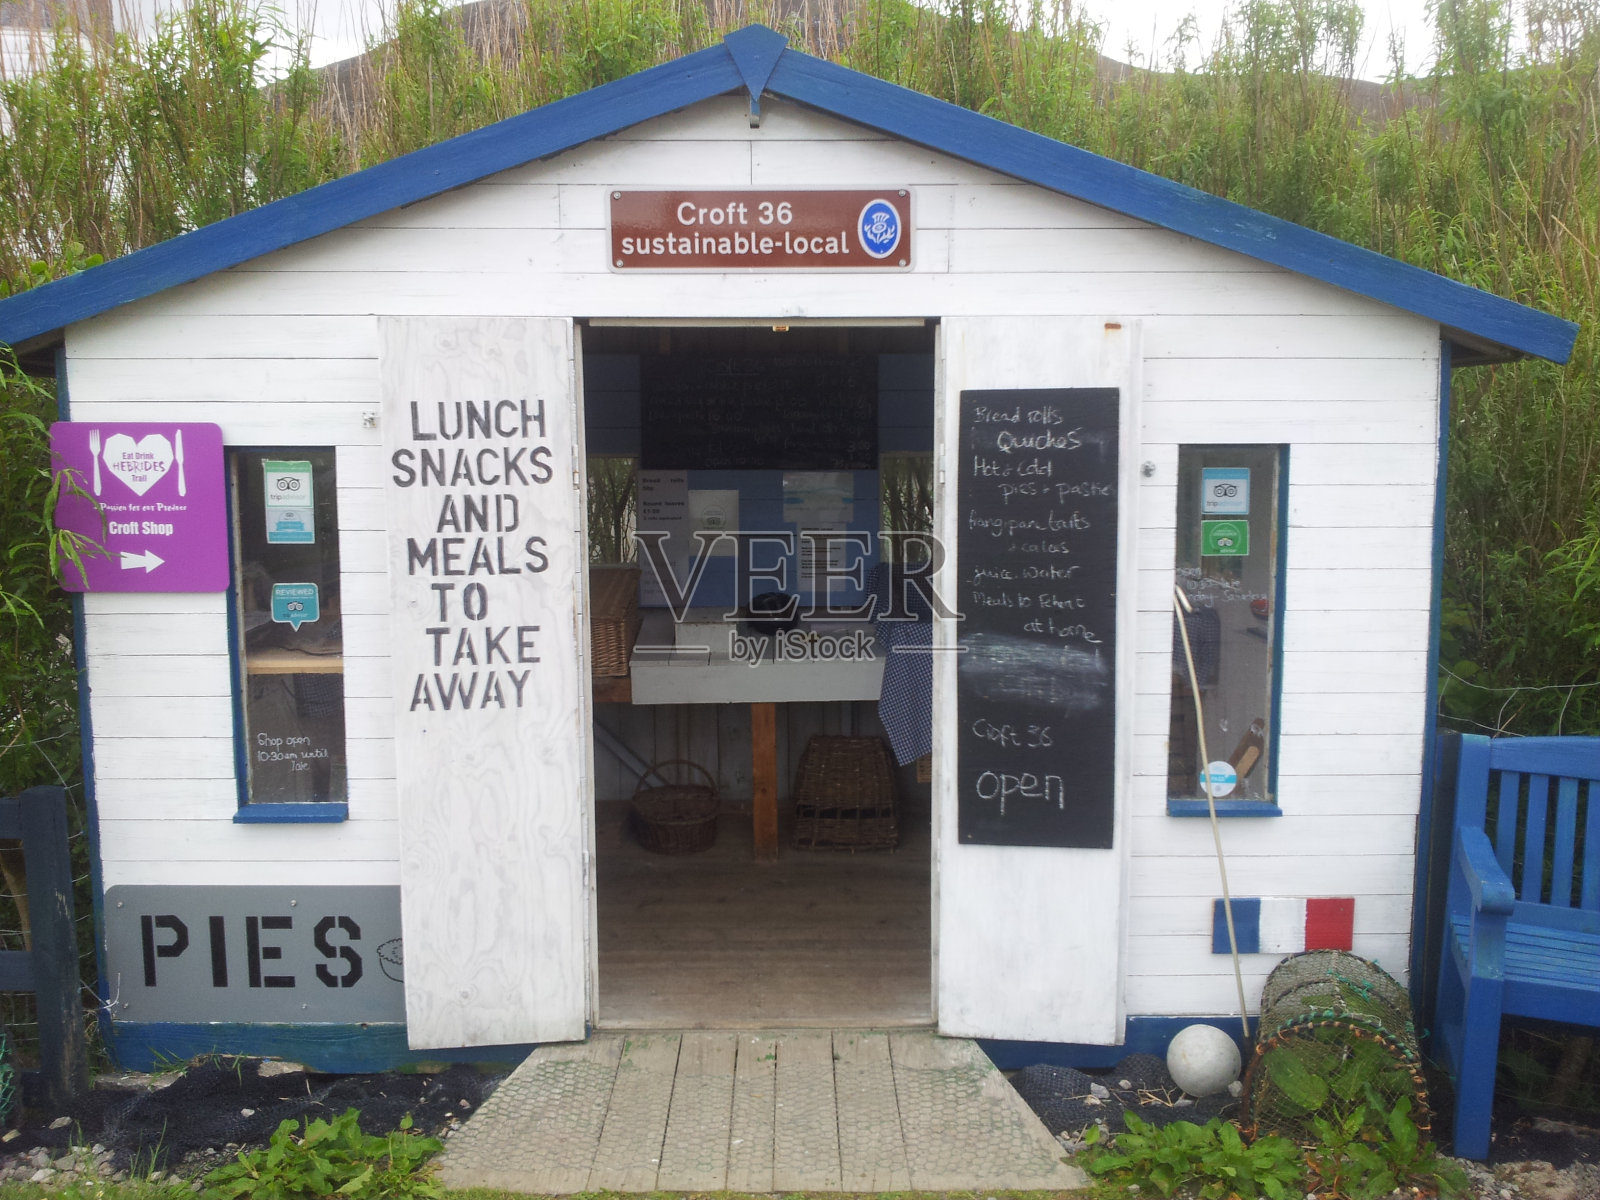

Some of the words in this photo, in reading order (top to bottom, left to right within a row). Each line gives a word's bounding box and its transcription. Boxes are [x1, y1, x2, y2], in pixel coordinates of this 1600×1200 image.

[677, 202, 748, 226] Croft
[758, 202, 793, 226] 36
[621, 231, 850, 255] sustainable-local
[410, 399, 547, 441] LUNCH
[122, 452, 134, 460] Eat
[135, 452, 154, 460] Drink
[391, 446, 554, 488] SNACKS
[131, 474, 147, 482] Trail
[108, 521, 139, 535] Croft
[142, 521, 173, 536] Shop
[436, 494, 519, 533] AND
[407, 536, 549, 576] MEALS
[431, 582, 489, 622] TO
[425, 625, 541, 666] TAKE
[409, 669, 531, 712] AWAY
[257, 732, 283, 752] Shop
[286, 736, 310, 748] open
[141, 914, 363, 988] PIES
